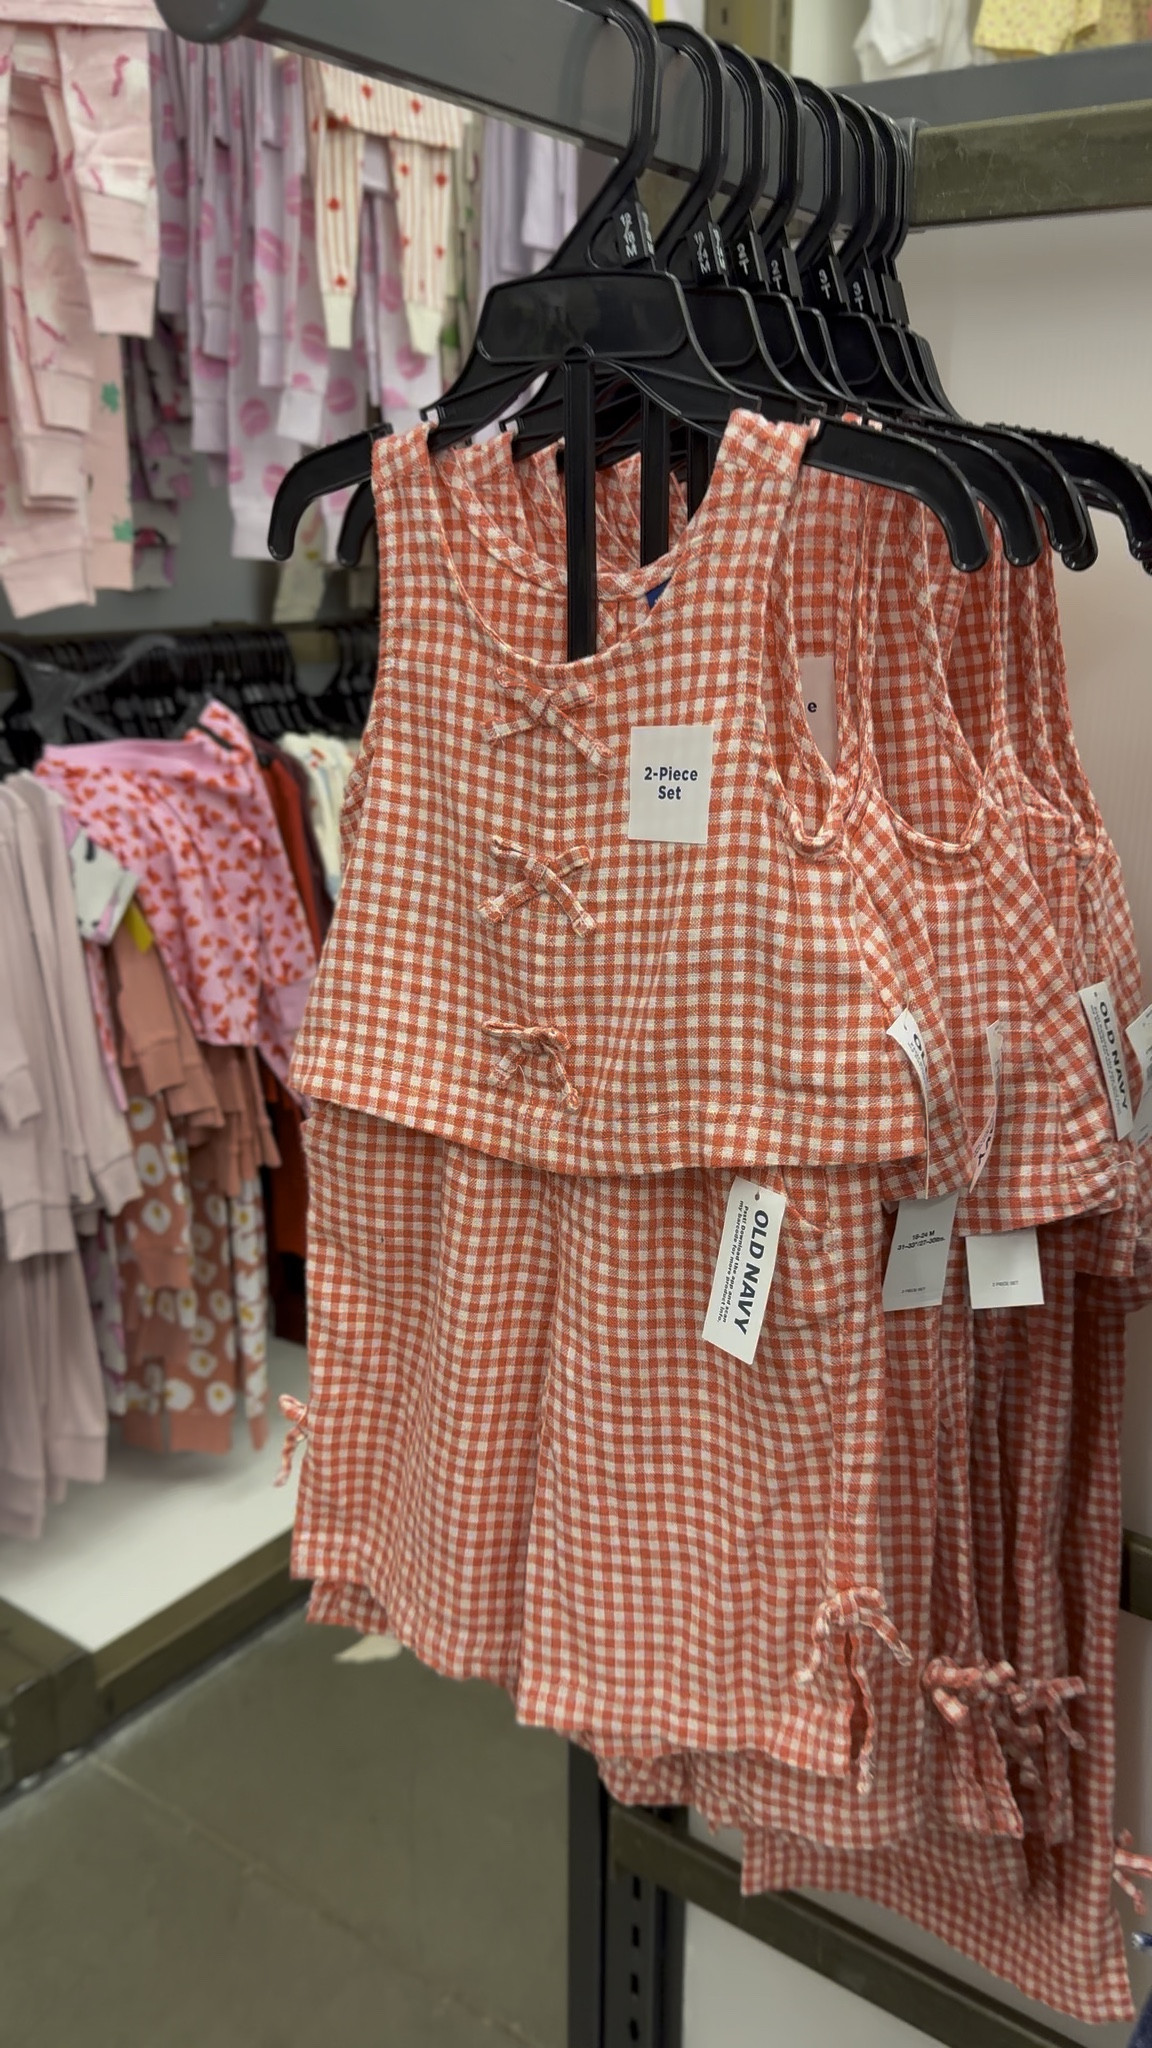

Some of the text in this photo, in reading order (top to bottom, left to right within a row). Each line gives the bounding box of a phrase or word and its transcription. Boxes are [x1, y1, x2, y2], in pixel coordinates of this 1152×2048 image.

[644, 766, 698, 781] 2-Piece
[658, 785, 682, 800] Set
[1099, 1001, 1115, 1045] OLD
[1111, 1050, 1128, 1109] NAVY
[733, 1213, 742, 1243] barcode
[735, 1225, 746, 1261] Download
[734, 1209, 769, 1336] OLD NAVY
[721, 1276, 730, 1305] product
